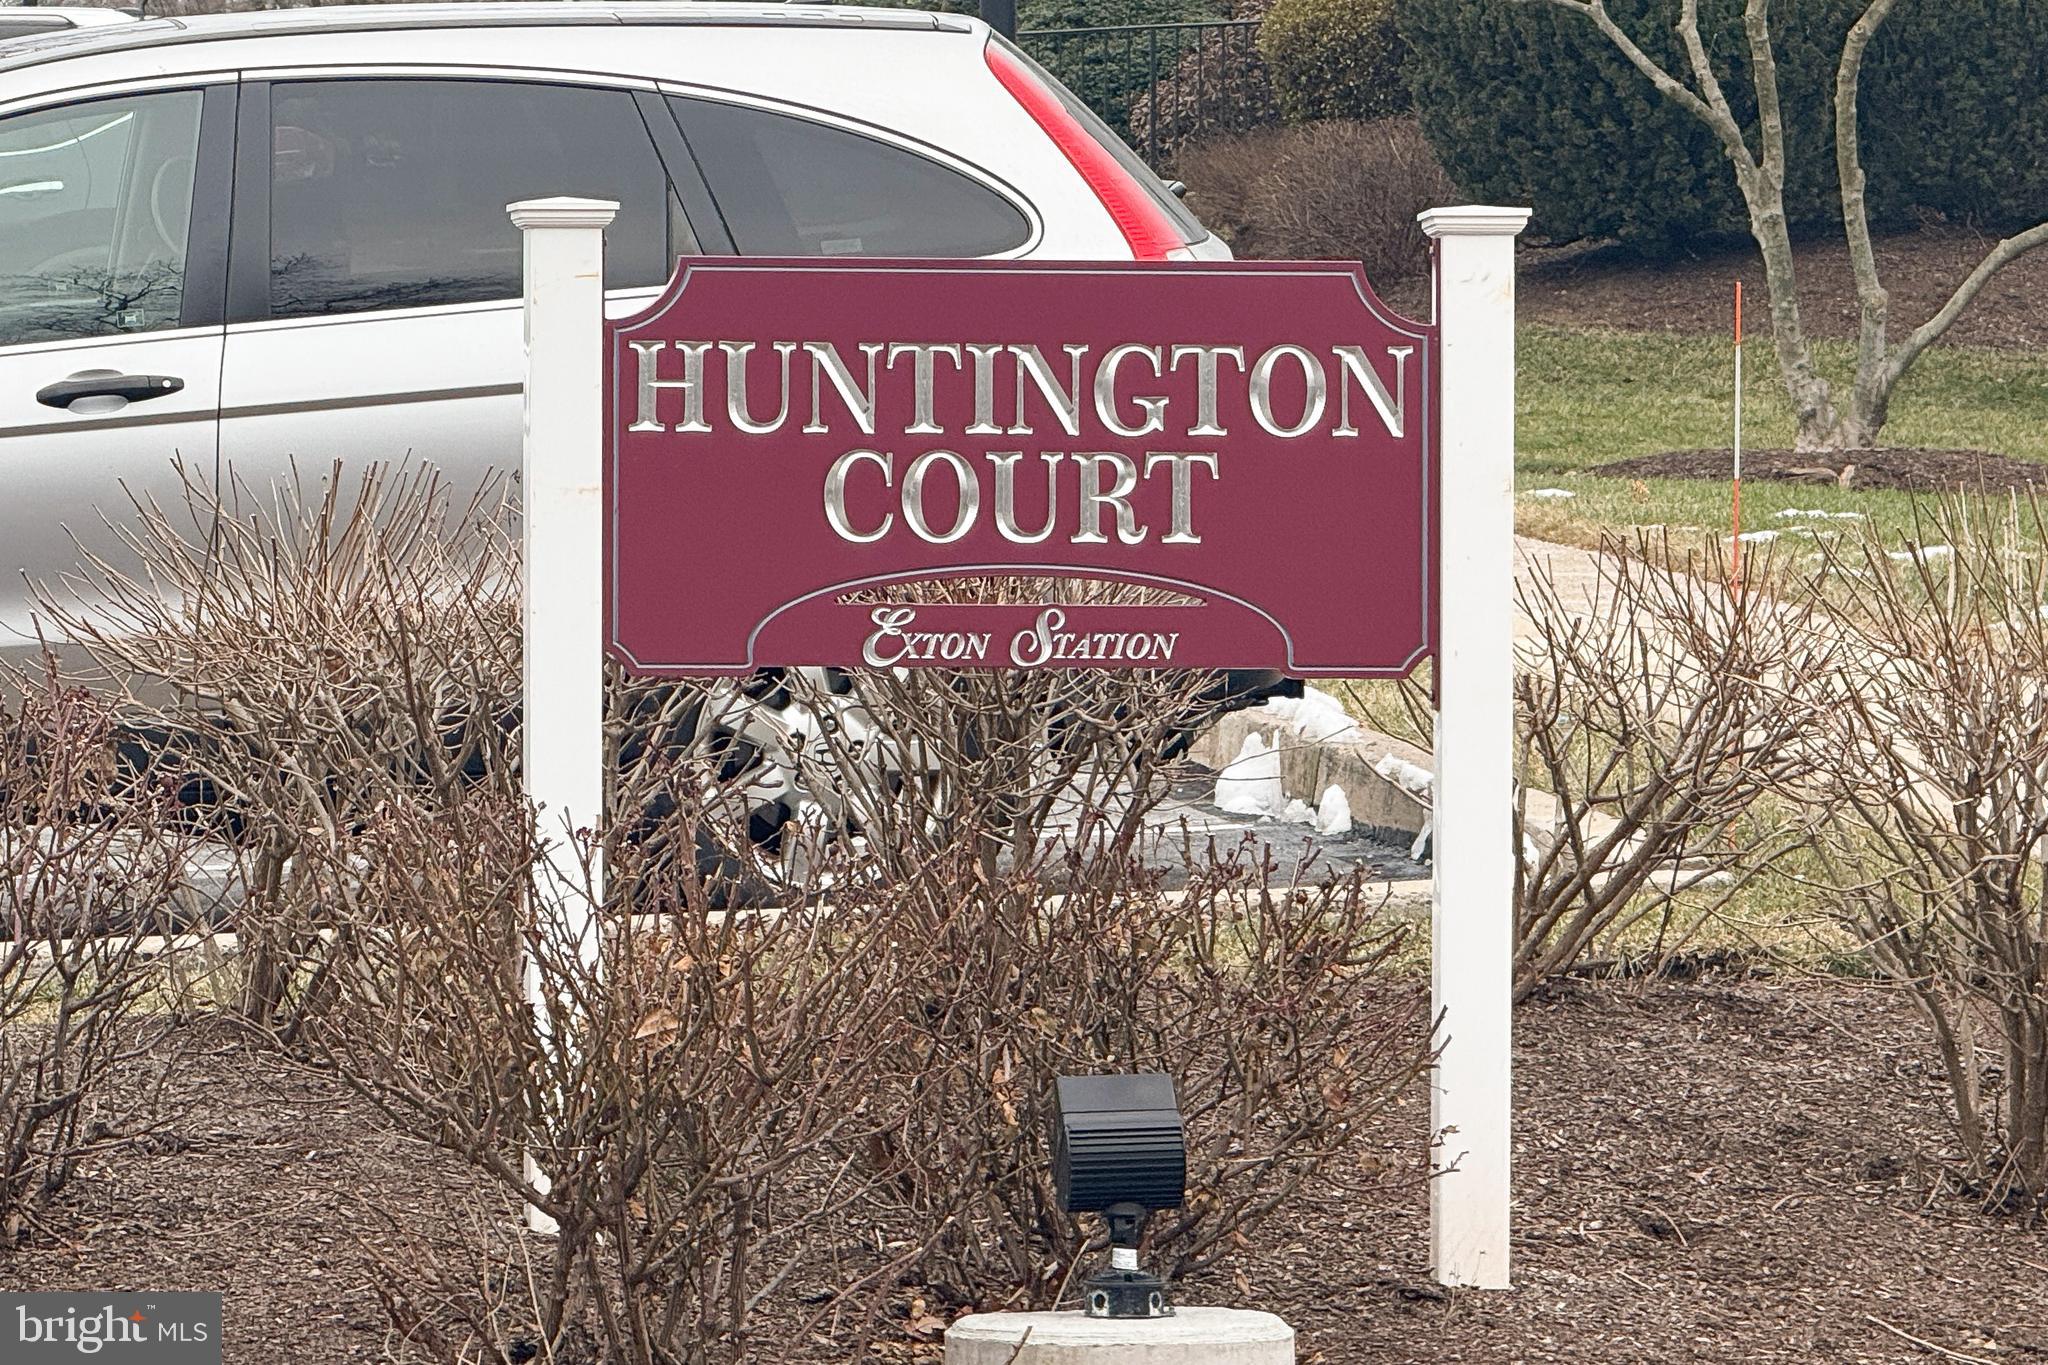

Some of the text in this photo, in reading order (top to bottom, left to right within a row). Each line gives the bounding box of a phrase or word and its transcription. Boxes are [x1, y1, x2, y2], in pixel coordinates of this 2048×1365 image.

[627, 340, 1413, 438] HUNTINGTON
[823, 450, 1220, 545] COURT
[862, 607, 1179, 667] EXTON STATION
